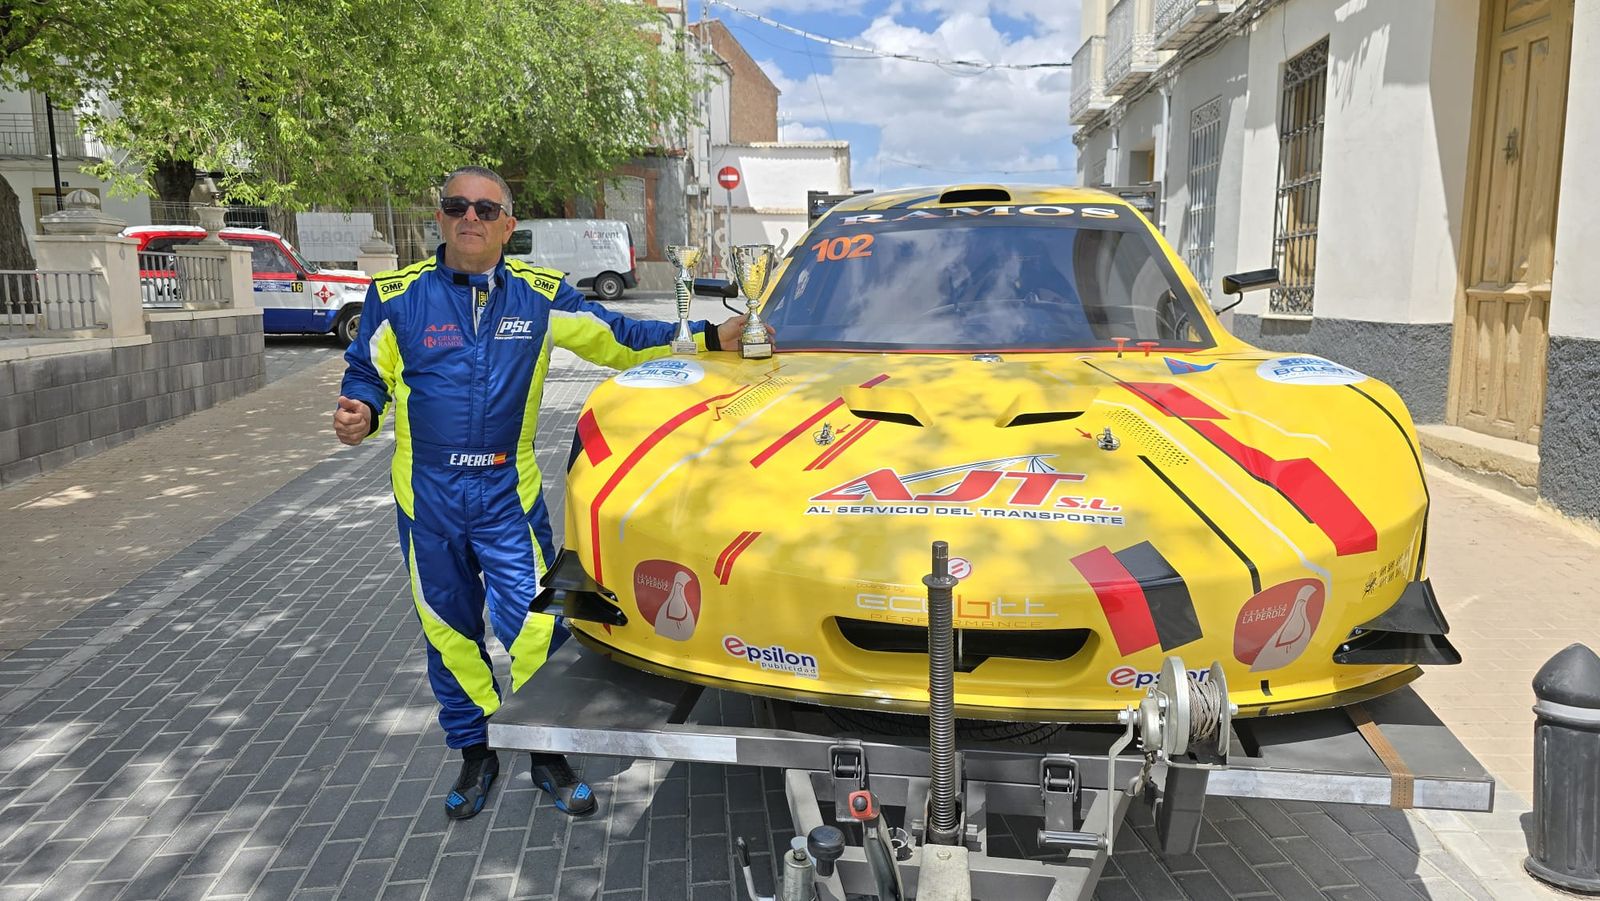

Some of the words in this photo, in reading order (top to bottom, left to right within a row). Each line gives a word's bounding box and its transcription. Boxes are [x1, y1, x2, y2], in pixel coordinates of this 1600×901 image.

[838, 205, 1120, 226] RAMOS
[812, 233, 875, 263] 102
[291, 282, 303, 293] 16
[381, 282, 404, 293] OMP
[533, 278, 555, 291] OMP
[809, 468, 1086, 505] AJT
[1055, 496, 1120, 511] S.L.
[806, 505, 830, 514] AL
[837, 506, 928, 515] SERVICIO
[935, 507, 973, 516] DEL
[980, 508, 1124, 525] TRANSPORTE
[637, 576, 645, 585] LA
[645, 578, 669, 592] PERDIZ
[870, 613, 1043, 628] PERFRMANCE
[1242, 614, 1253, 624] LA
[1255, 608, 1287, 622] PERDIZ
[724, 637, 816, 667] epsilon
[761, 662, 816, 674] publicidad
